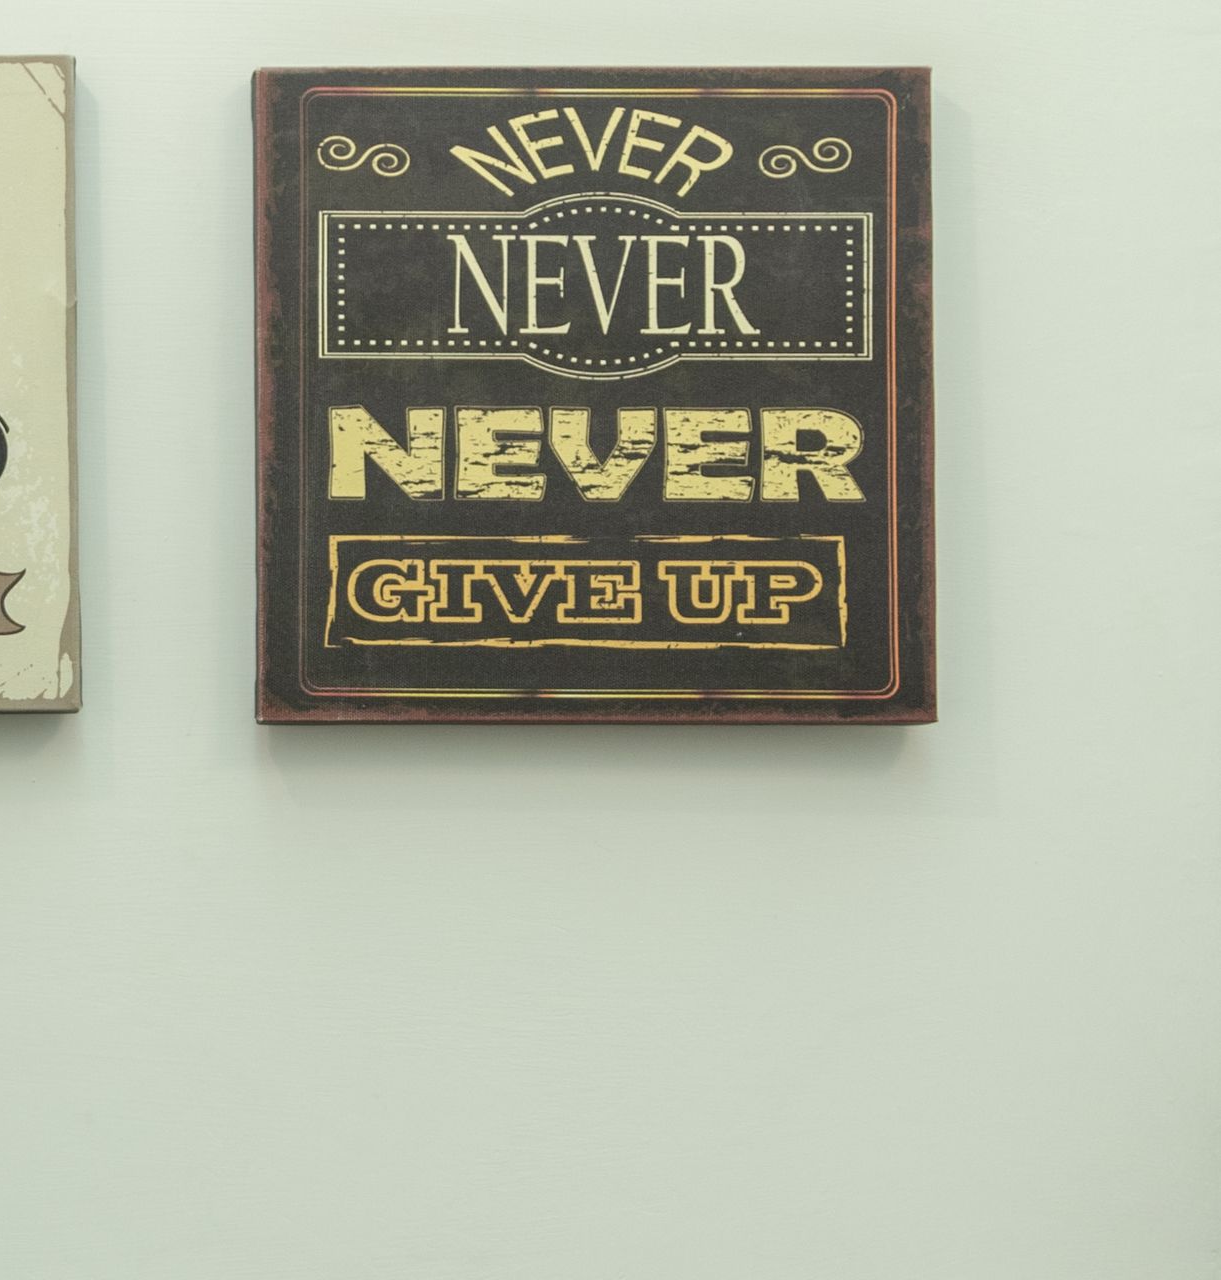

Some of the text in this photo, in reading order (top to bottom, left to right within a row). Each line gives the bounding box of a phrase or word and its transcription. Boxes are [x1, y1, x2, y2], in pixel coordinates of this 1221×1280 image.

[449, 106, 734, 198] NEVER
[447, 233, 761, 336] NEVER
[328, 404, 867, 503] NEVER
[347, 559, 824, 625] GIVE UP
